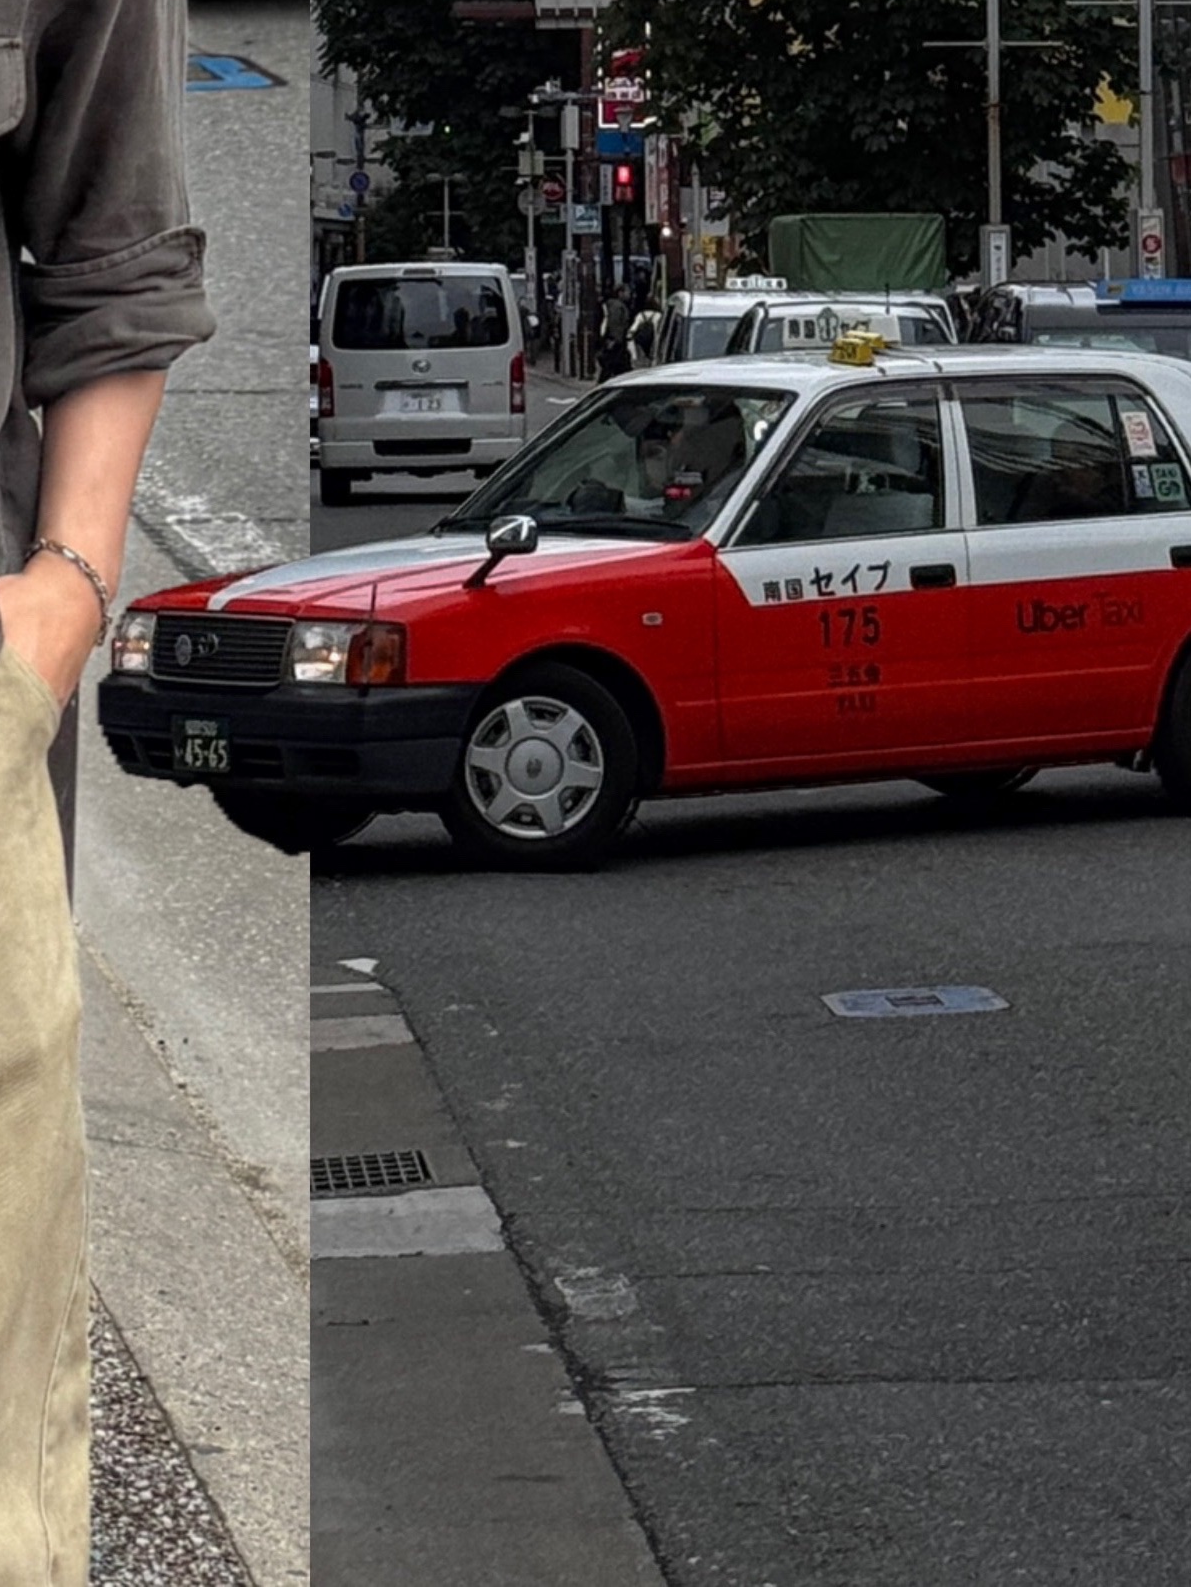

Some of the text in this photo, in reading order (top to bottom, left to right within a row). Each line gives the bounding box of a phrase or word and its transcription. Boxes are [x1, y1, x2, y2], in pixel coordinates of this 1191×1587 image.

[819, 605, 881, 648] 175
[1016, 591, 1143, 633] Uber Taxi
